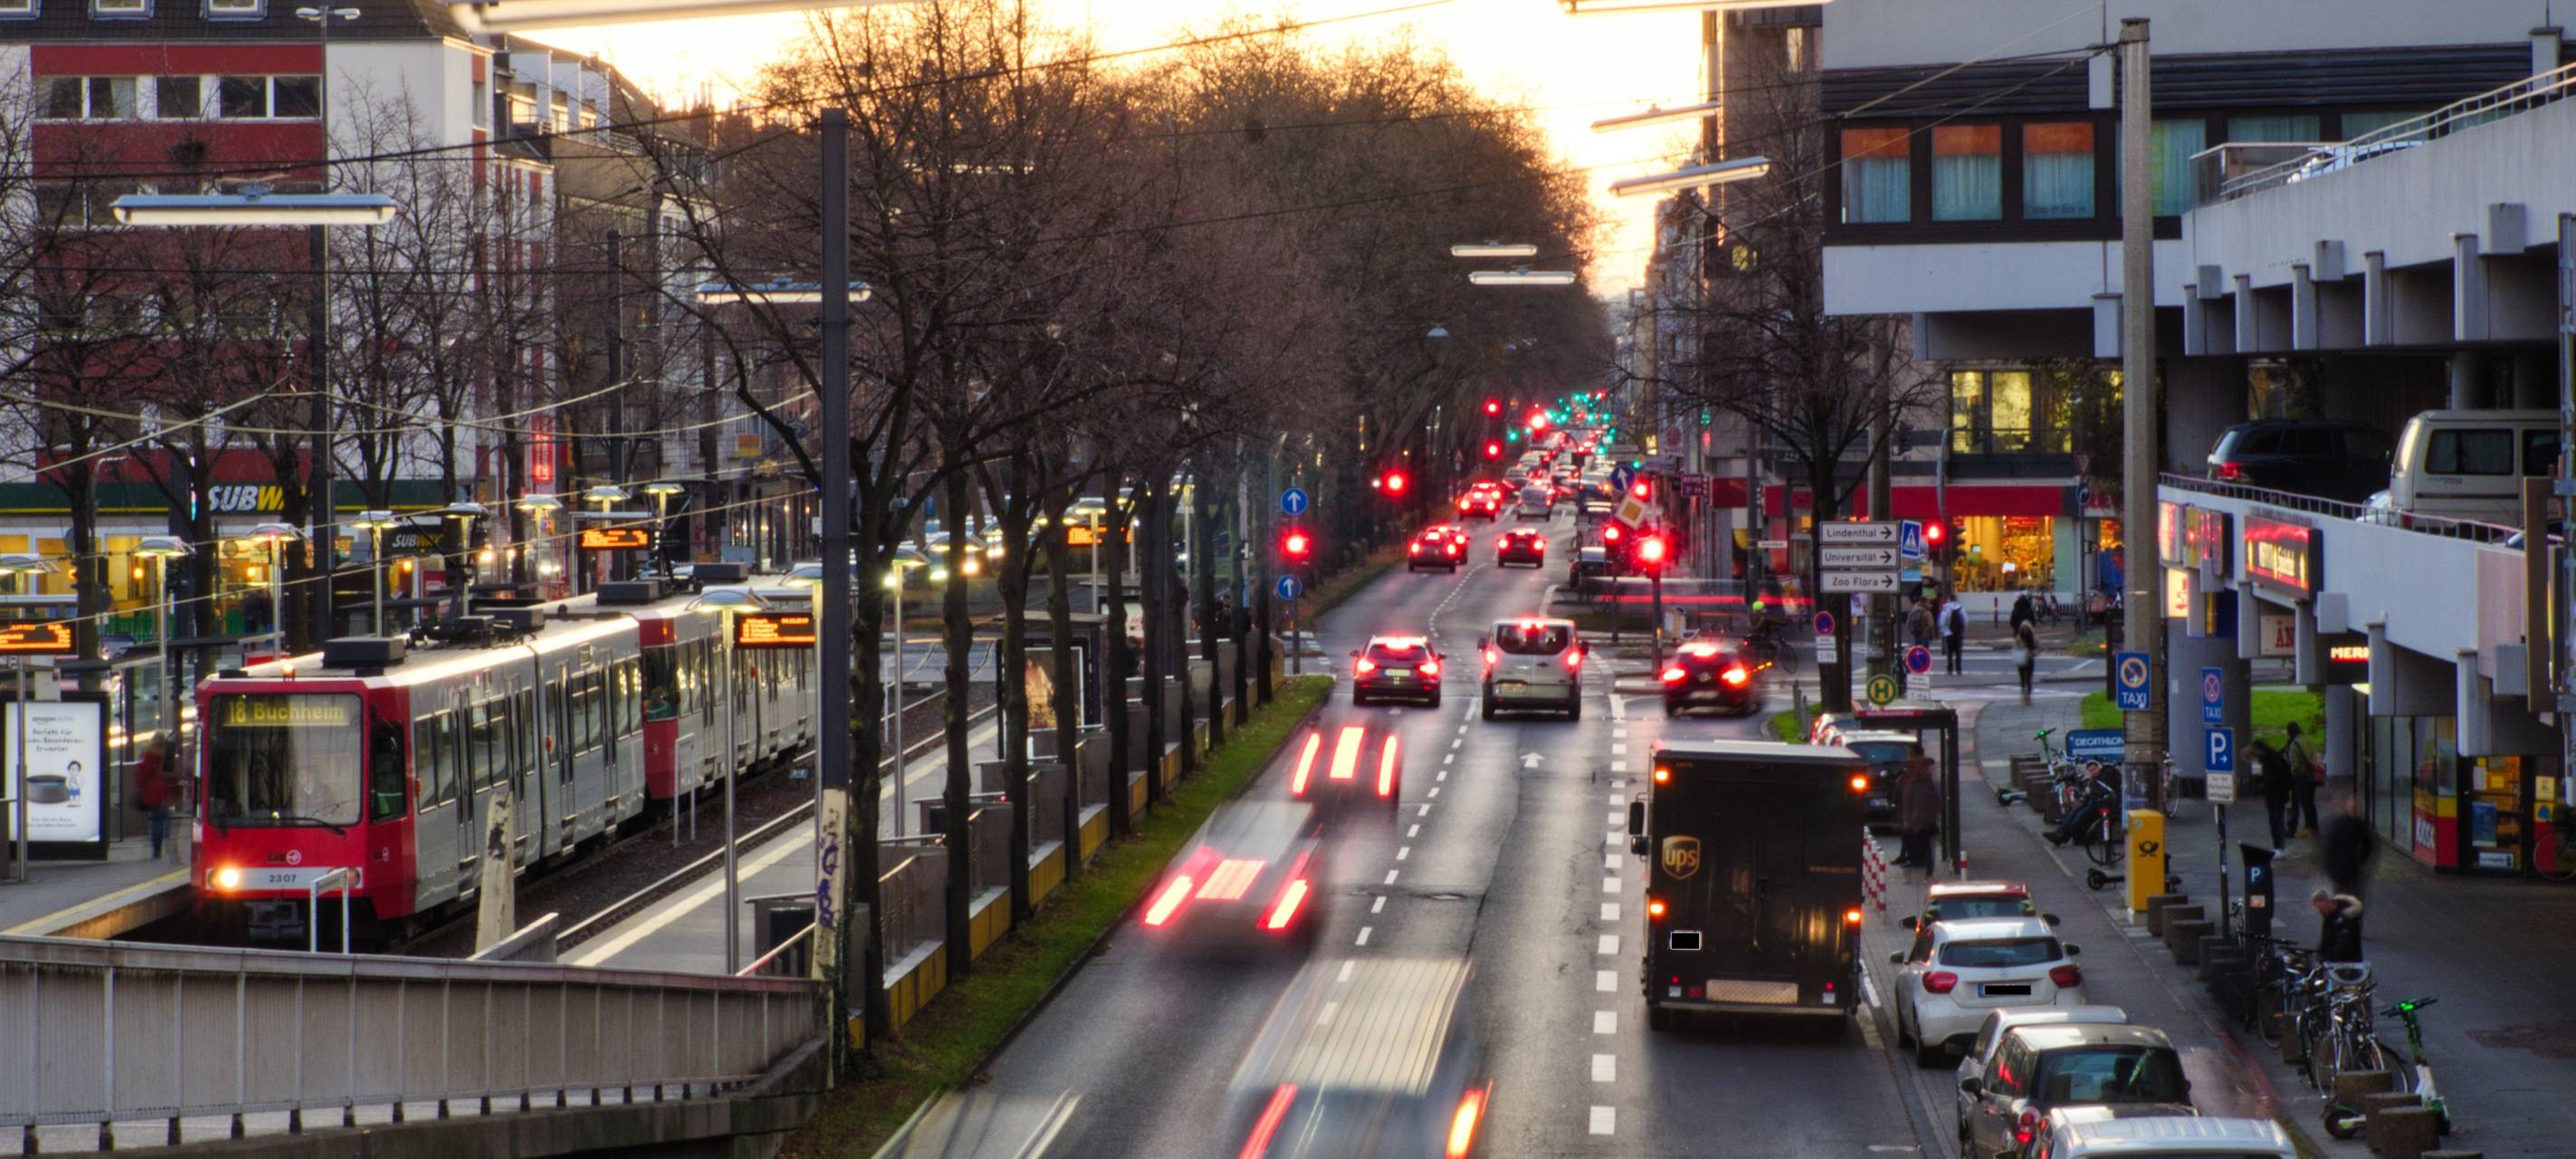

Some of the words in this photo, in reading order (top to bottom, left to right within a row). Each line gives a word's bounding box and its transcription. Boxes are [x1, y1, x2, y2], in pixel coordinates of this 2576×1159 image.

[207, 485, 306, 512] SUBW
[1827, 528, 1876, 537] Lindenthal
[1825, 552, 1876, 561] Universität
[1832, 578, 1849, 586] Zoo
[1853, 578, 1878, 586] Flora
[1874, 680, 1890, 698] H
[2122, 692, 2147, 704] TAXI
[230, 702, 246, 723] 18
[253, 702, 344, 720] Buchheim
[2205, 706, 2221, 719] TAXI
[2210, 733, 2226, 765] P
[1665, 849, 1696, 872] ups
[269, 874, 297, 883] 2307
[2251, 867, 2261, 882] P
